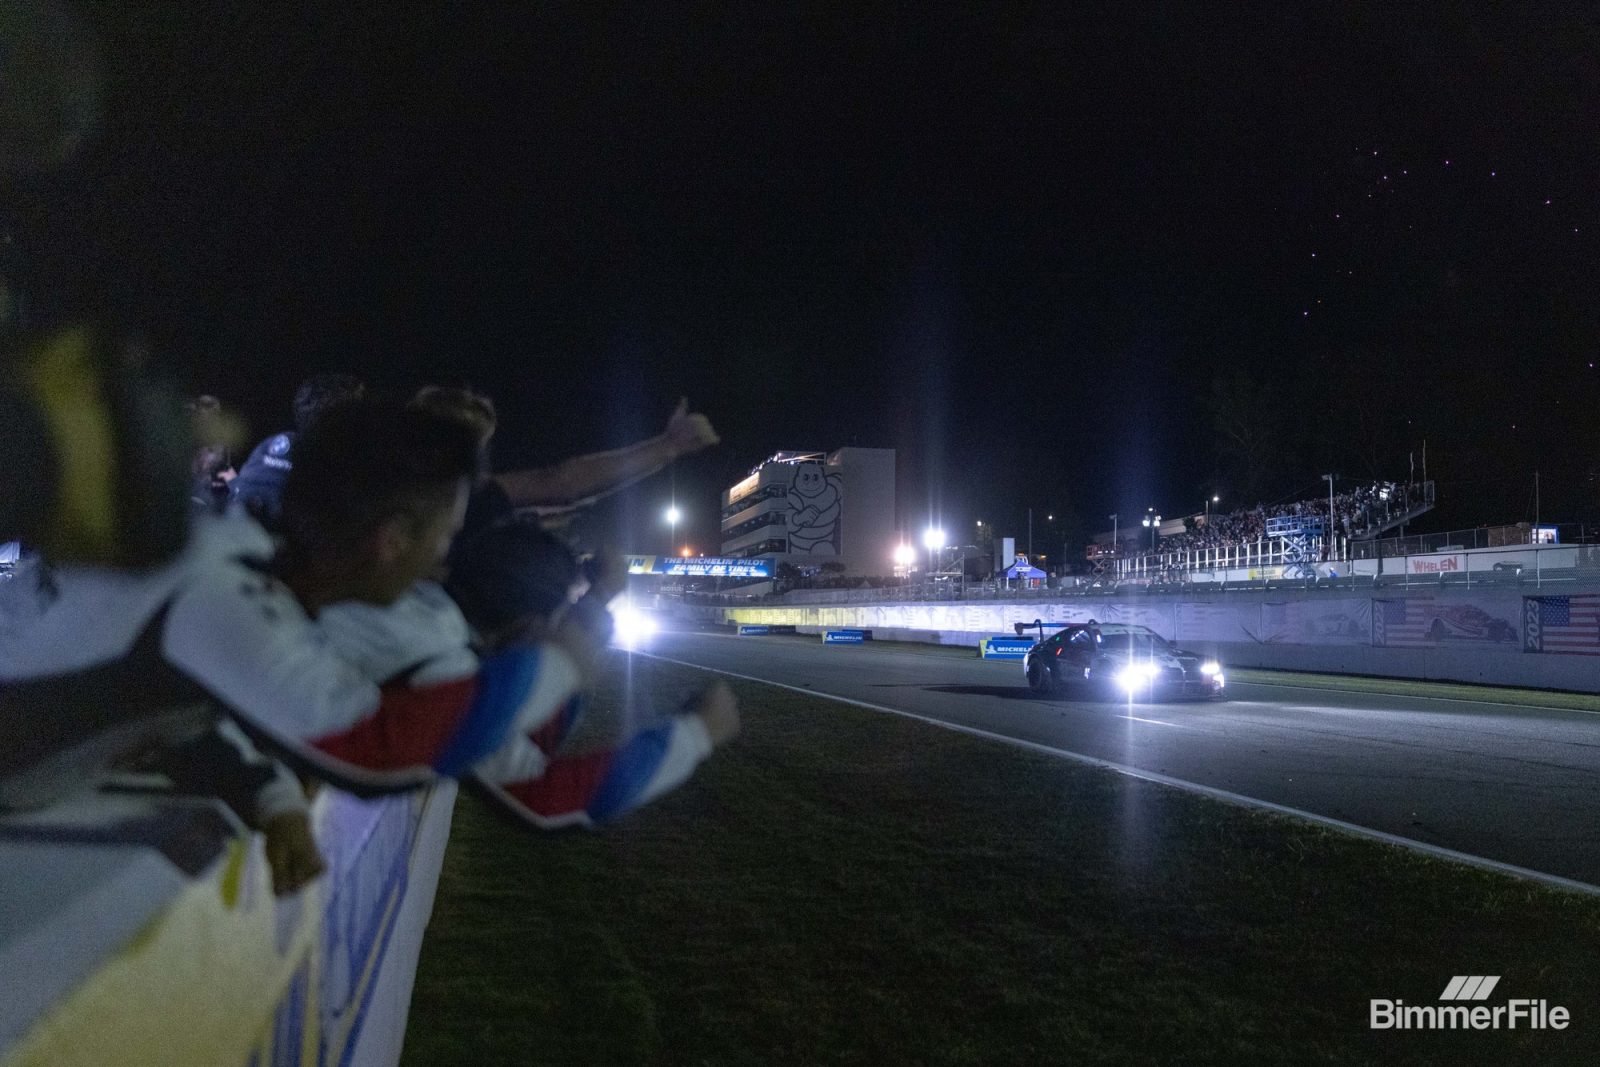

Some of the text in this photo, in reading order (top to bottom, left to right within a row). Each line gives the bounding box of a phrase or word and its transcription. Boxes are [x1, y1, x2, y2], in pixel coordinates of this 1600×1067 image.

[684, 557, 734, 566] MICHELIN
[1413, 556, 1458, 573] WHELEN
[1526, 599, 1540, 650] 2023
